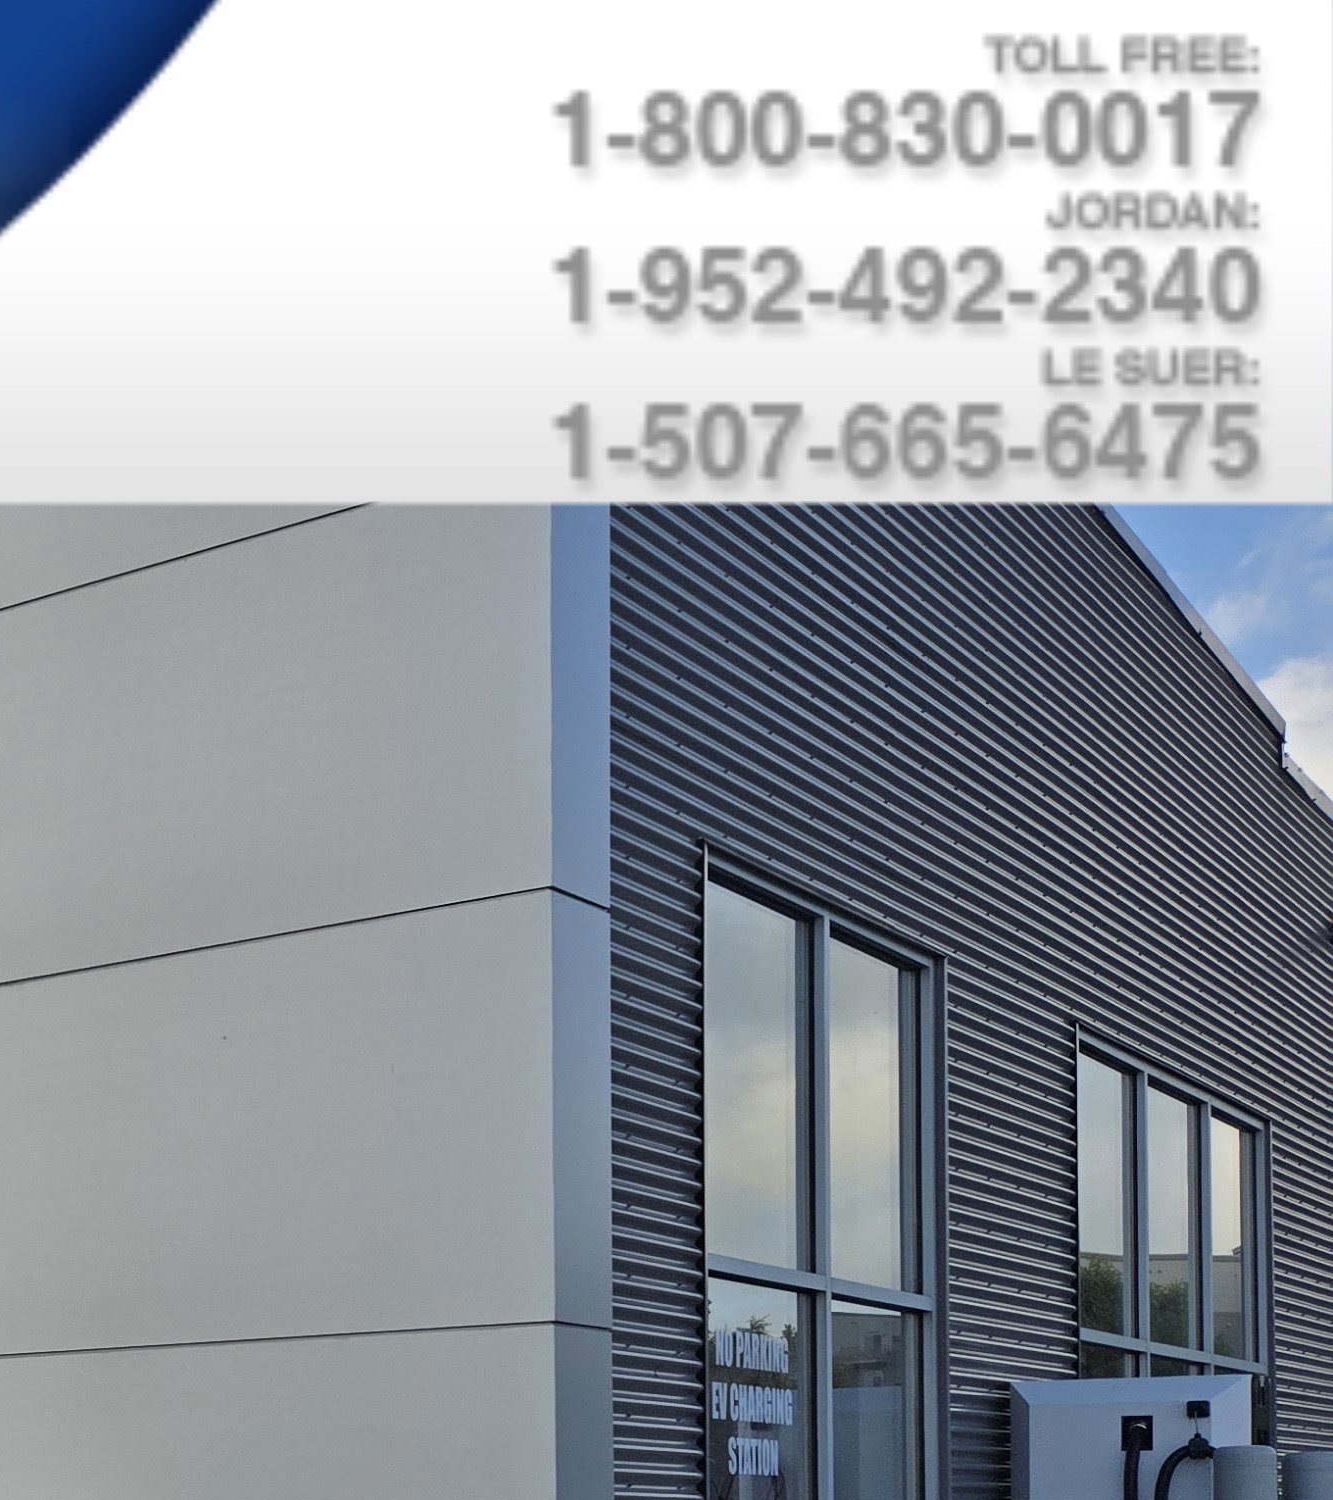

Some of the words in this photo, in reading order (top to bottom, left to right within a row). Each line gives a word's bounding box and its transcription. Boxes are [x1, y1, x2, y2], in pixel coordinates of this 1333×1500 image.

[715, 1329, 734, 1367] NO
[736, 1331, 789, 1373] PARKING
[711, 1381, 728, 1420] EV
[730, 1382, 793, 1426] CHARGING
[728, 1436, 779, 1477] STATION
